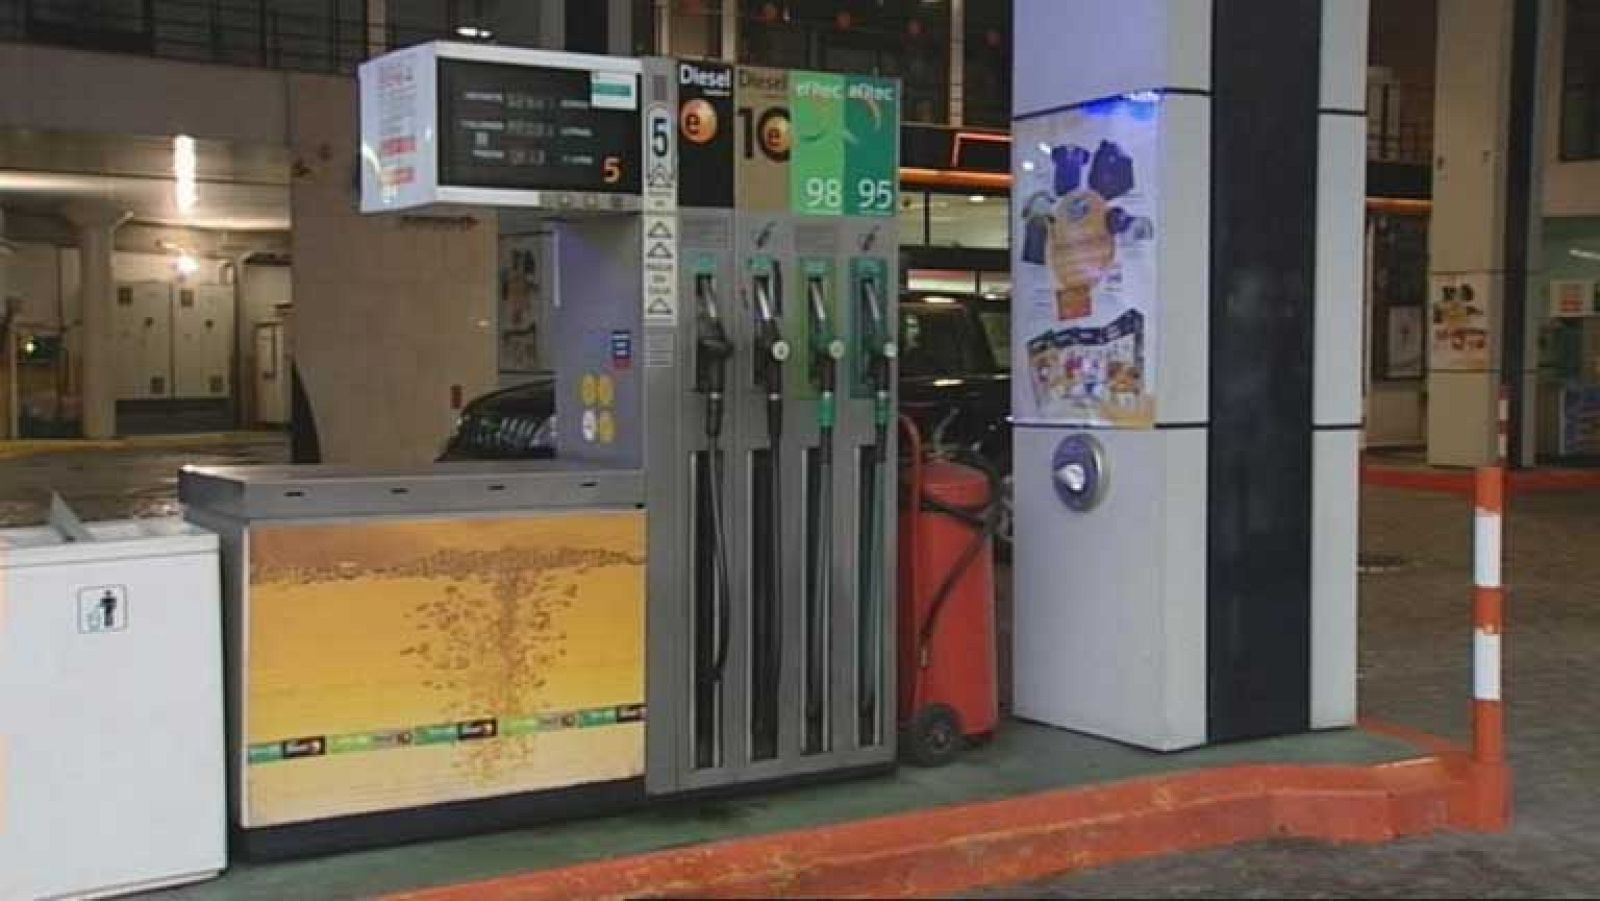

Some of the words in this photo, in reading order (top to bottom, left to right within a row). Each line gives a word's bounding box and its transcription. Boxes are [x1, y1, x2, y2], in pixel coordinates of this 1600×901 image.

[680, 64, 731, 88] Diesel
[652, 118, 669, 157] 5
[602, 157, 620, 183] 5
[806, 177, 842, 209] 98
[857, 178, 893, 210] 95
